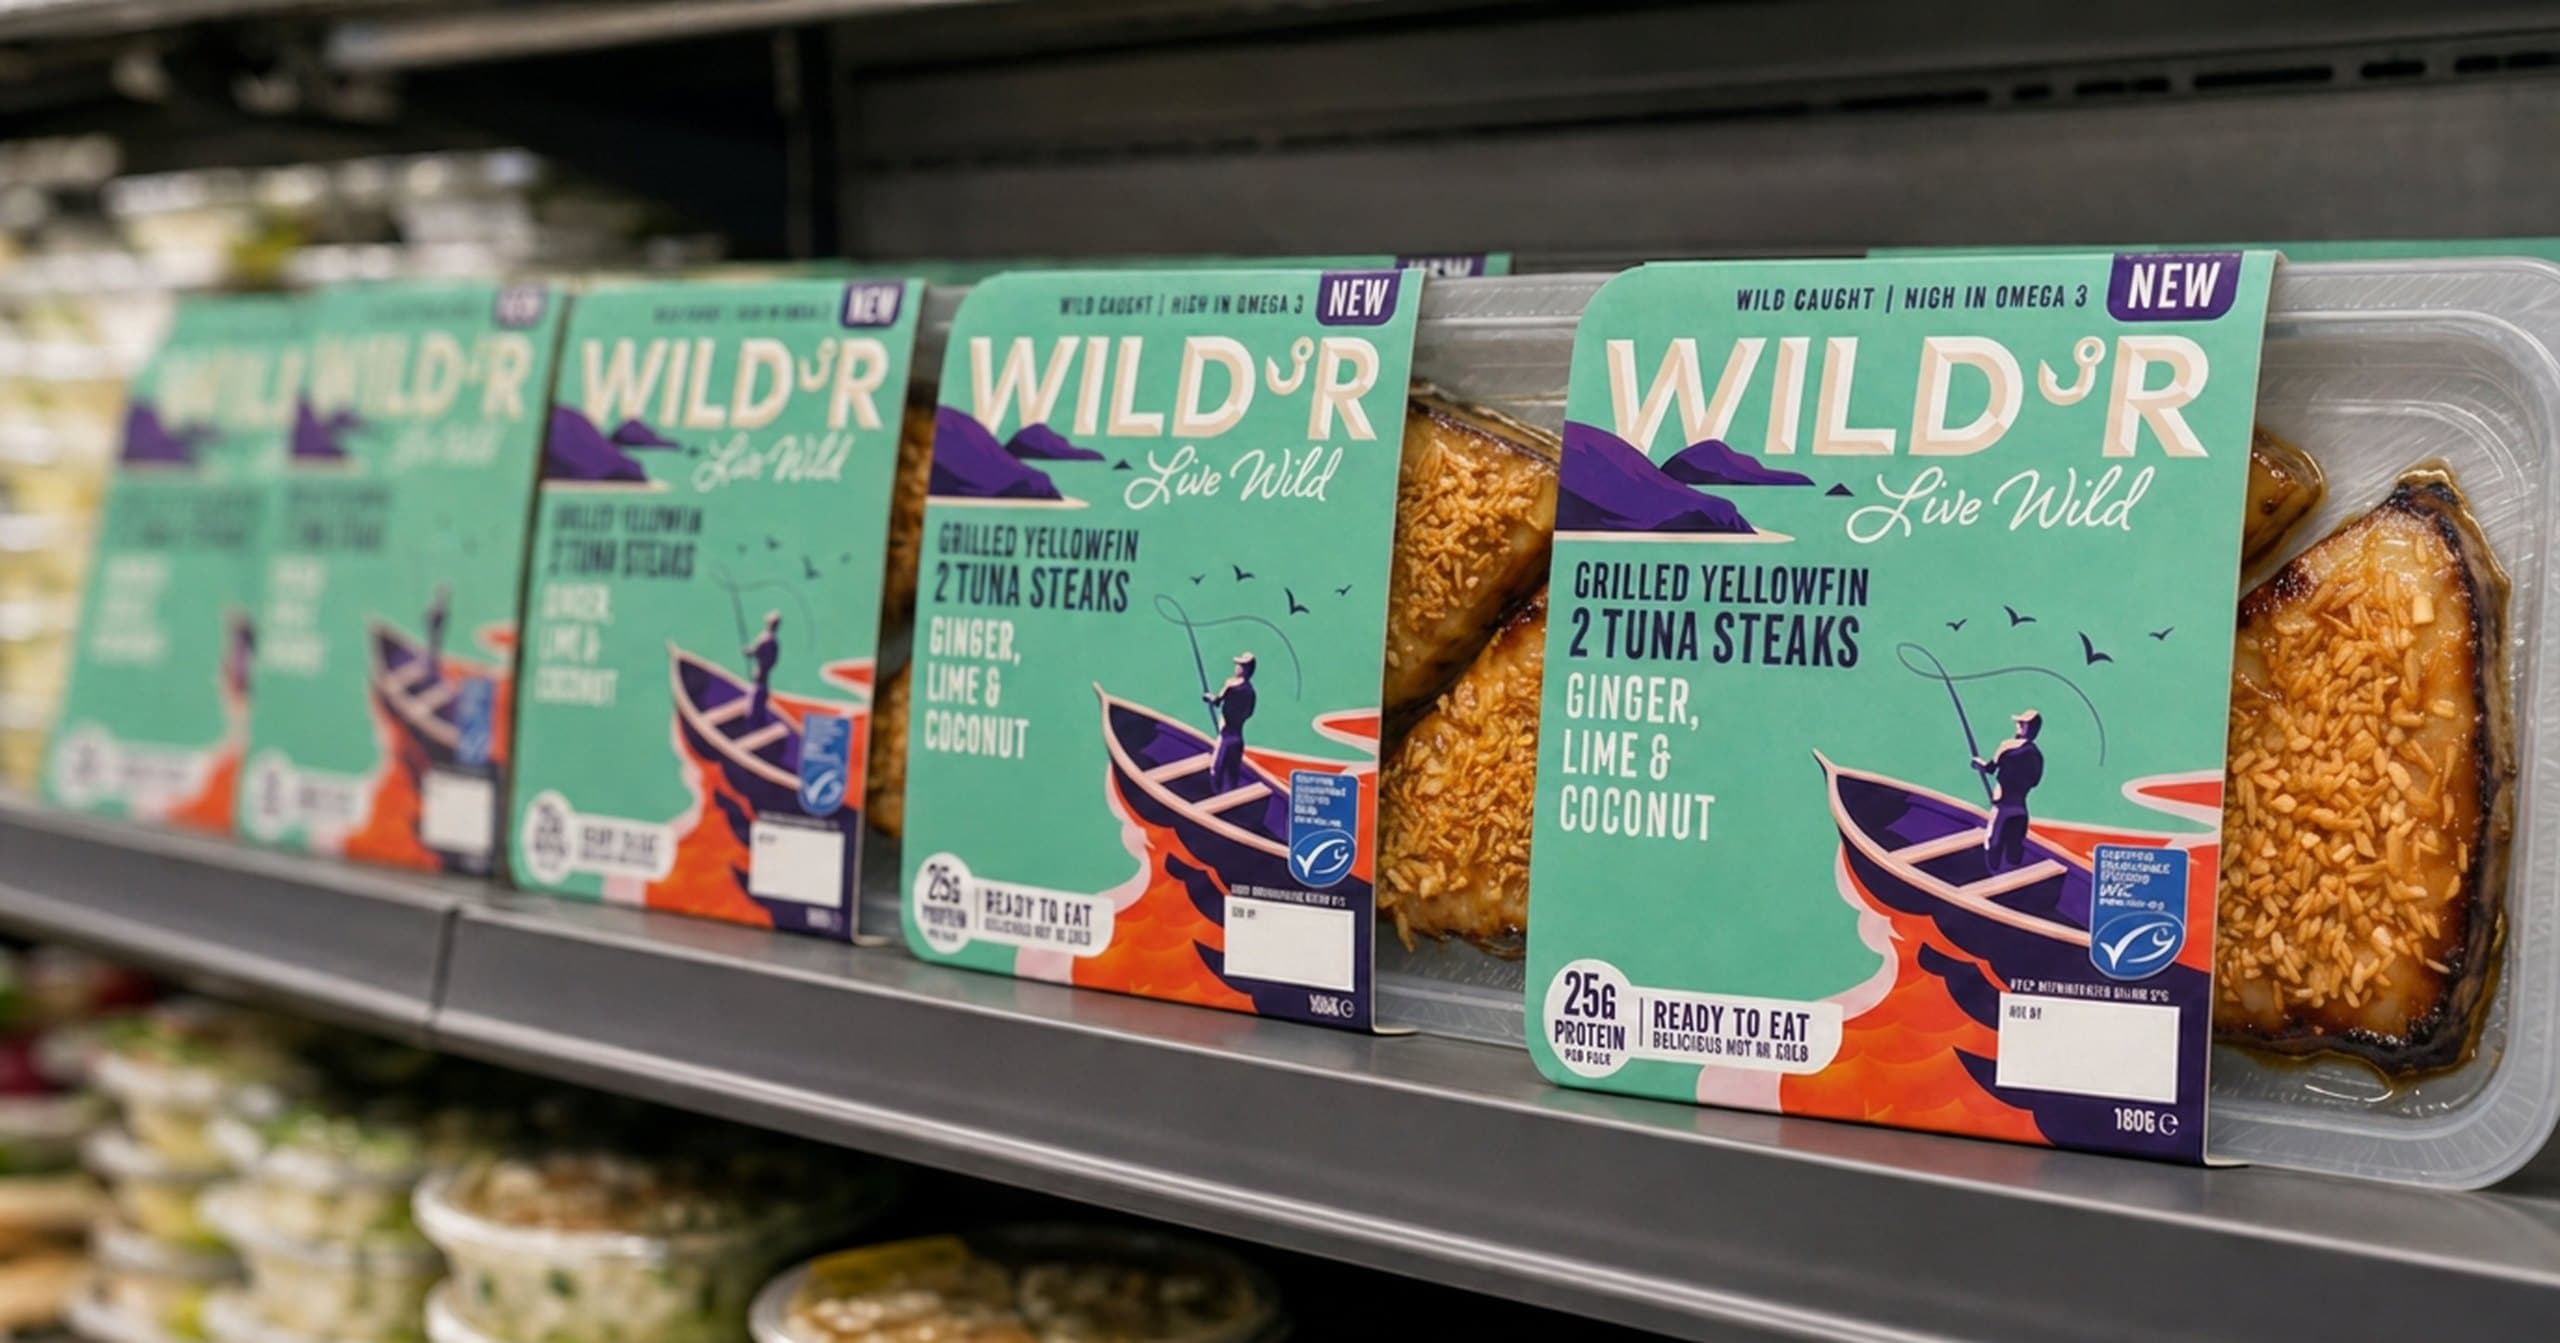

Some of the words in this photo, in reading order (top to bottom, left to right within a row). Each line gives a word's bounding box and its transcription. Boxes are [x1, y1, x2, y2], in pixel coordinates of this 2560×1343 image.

[845, 285, 898, 326] NEW
[1237, 293, 1289, 315] OMEGA
[1293, 292, 1305, 315] 3
[1328, 278, 1390, 318] NEW
[1737, 288, 1786, 311] WILD
[1794, 287, 1876, 311] CAUGHT
[1963, 285, 1988, 309] IN
[1995, 284, 2067, 309] OMEGA
[2074, 284, 2089, 308] 3
[2126, 260, 2222, 310] NEW
[1123, 446, 1221, 510] Live
[1229, 446, 1345, 503] Wild
[1845, 465, 1983, 544] Live
[1992, 464, 2157, 534] Wild
[938, 521, 1018, 558] GRILLED
[1024, 526, 1140, 563] YELLOWFIN
[933, 560, 951, 604] 2
[955, 561, 1021, 607] TUNA
[1028, 565, 1131, 614] STEAKS
[1573, 560, 1690, 602] GRILLED
[1701, 564, 1870, 607] YELLOWFIN
[928, 614, 1022, 668] GINGER,
[1569, 606, 1590, 658] 2
[1601, 608, 1699, 661] TUNA
[1713, 611, 1861, 668] STEAKS
[925, 661, 981, 706] LIME
[983, 665, 1002, 709] &
[1566, 671, 1699, 730] GINGER,
[923, 708, 1030, 761] COCONUT
[1562, 729, 1639, 779] LIME
[1649, 733, 1671, 781] &
[1559, 784, 1716, 841] COCONUT
[1038, 897, 1059, 925] TO
[1563, 970, 1616, 1020] 25G
[1554, 1019, 1626, 1051] PROTEIN
[1653, 1000, 1724, 1035] READY
[1733, 1007, 1761, 1038] TO
[1770, 1010, 1811, 1042] EAT
